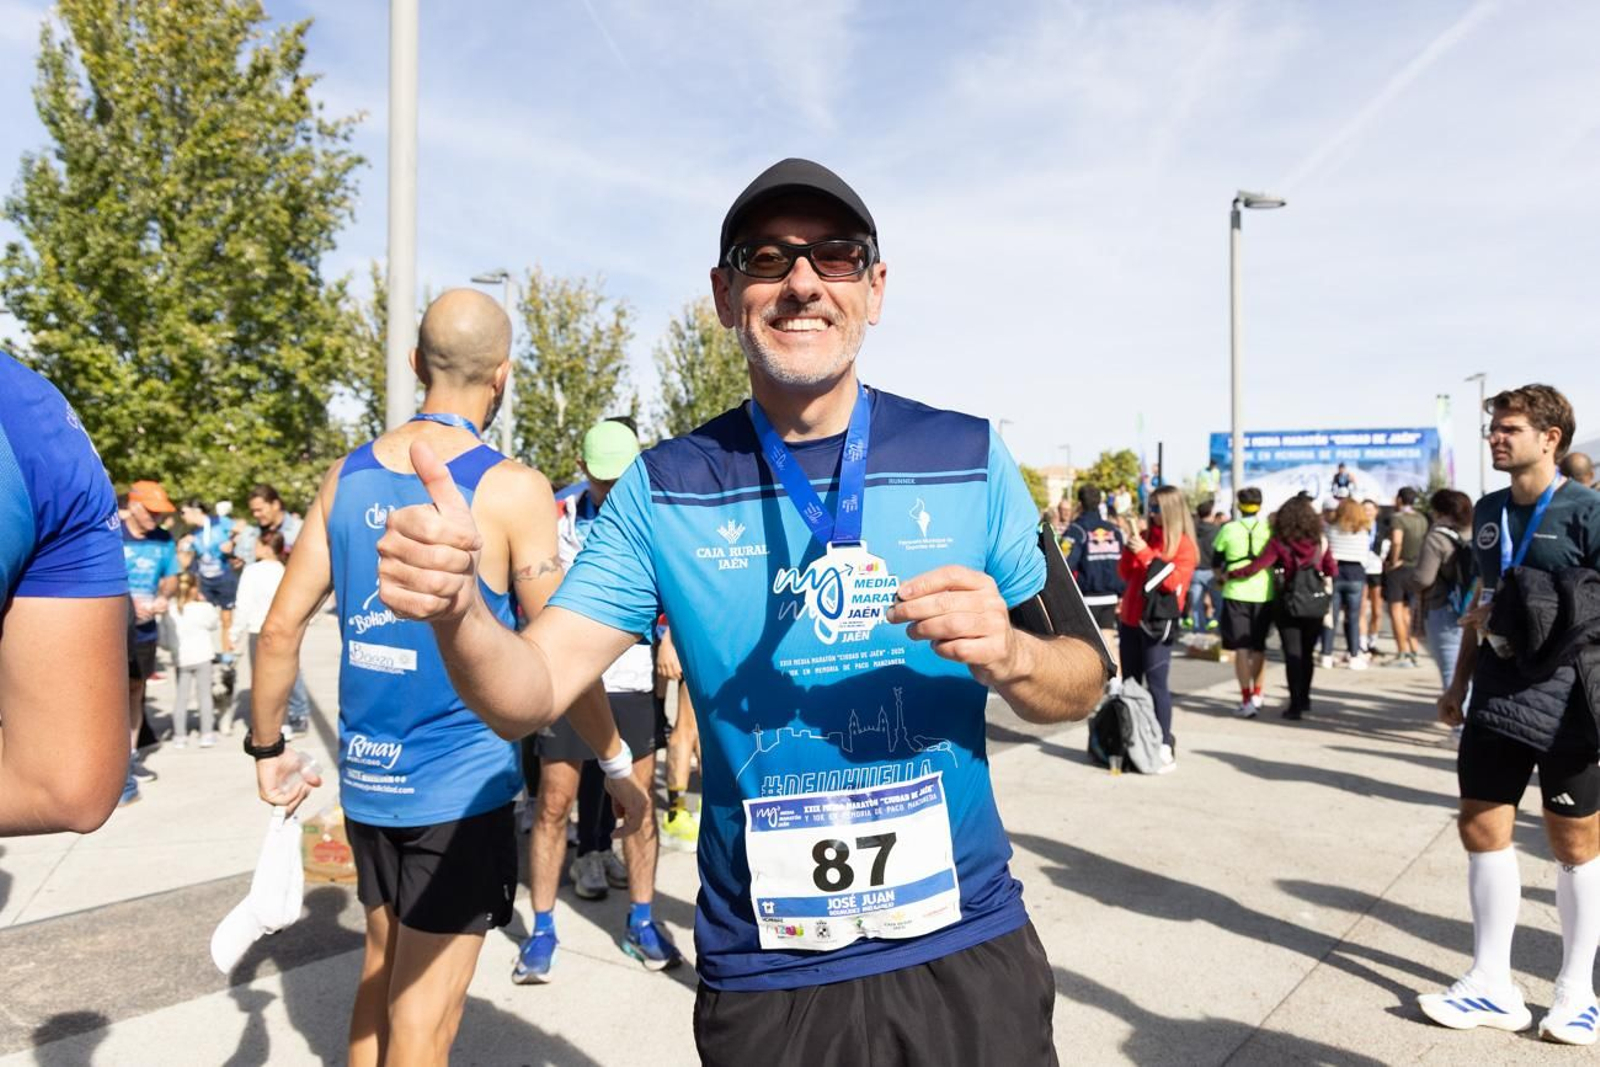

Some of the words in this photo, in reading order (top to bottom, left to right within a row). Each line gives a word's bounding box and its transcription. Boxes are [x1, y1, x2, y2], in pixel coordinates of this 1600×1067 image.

[696, 547, 725, 558] CAJA
[729, 544, 767, 557] RURAL
[718, 557, 748, 570] JAÉN
[854, 577, 897, 589] MEDIA
[851, 592, 898, 604] MARAT
[847, 605, 880, 619] JAÉN
[347, 734, 402, 769] Rmay
[803, 805, 821, 813] XXIX
[846, 797, 879, 810] MARATÓN
[911, 790, 919, 799] DE
[804, 814, 809, 822] Y
[886, 803, 904, 813] PACO
[811, 831, 897, 893] 87
[827, 893, 857, 910] JOSÉ
[862, 890, 895, 906] JUAN
